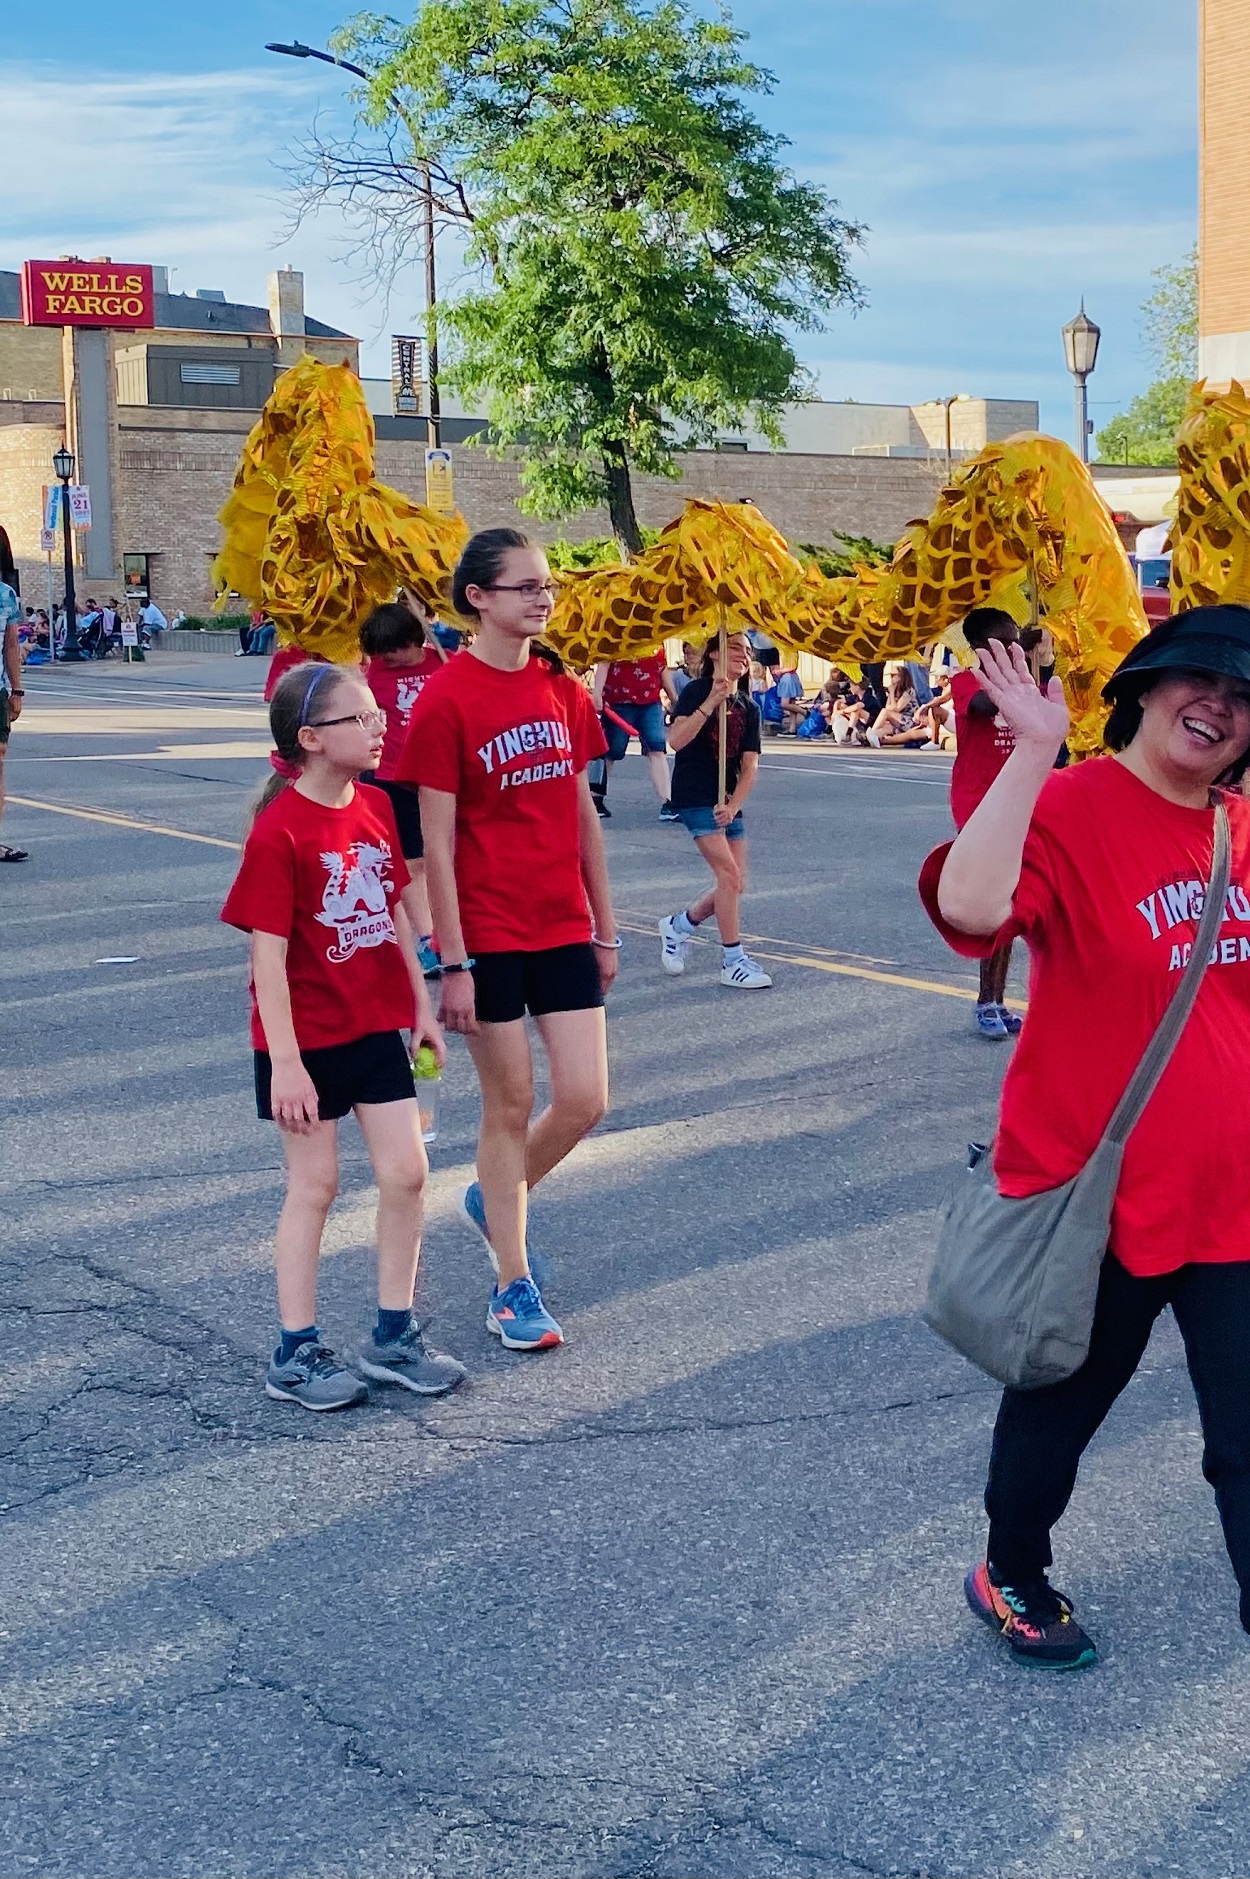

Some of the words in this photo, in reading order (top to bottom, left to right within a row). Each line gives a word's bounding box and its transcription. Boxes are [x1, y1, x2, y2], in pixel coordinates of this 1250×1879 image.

[40, 272, 144, 295] WELLS
[45, 295, 144, 317] FARGO
[402, 344, 411, 384] CENTRAL
[74, 499, 88, 510] 21
[500, 758, 574, 791] ACADEMY
